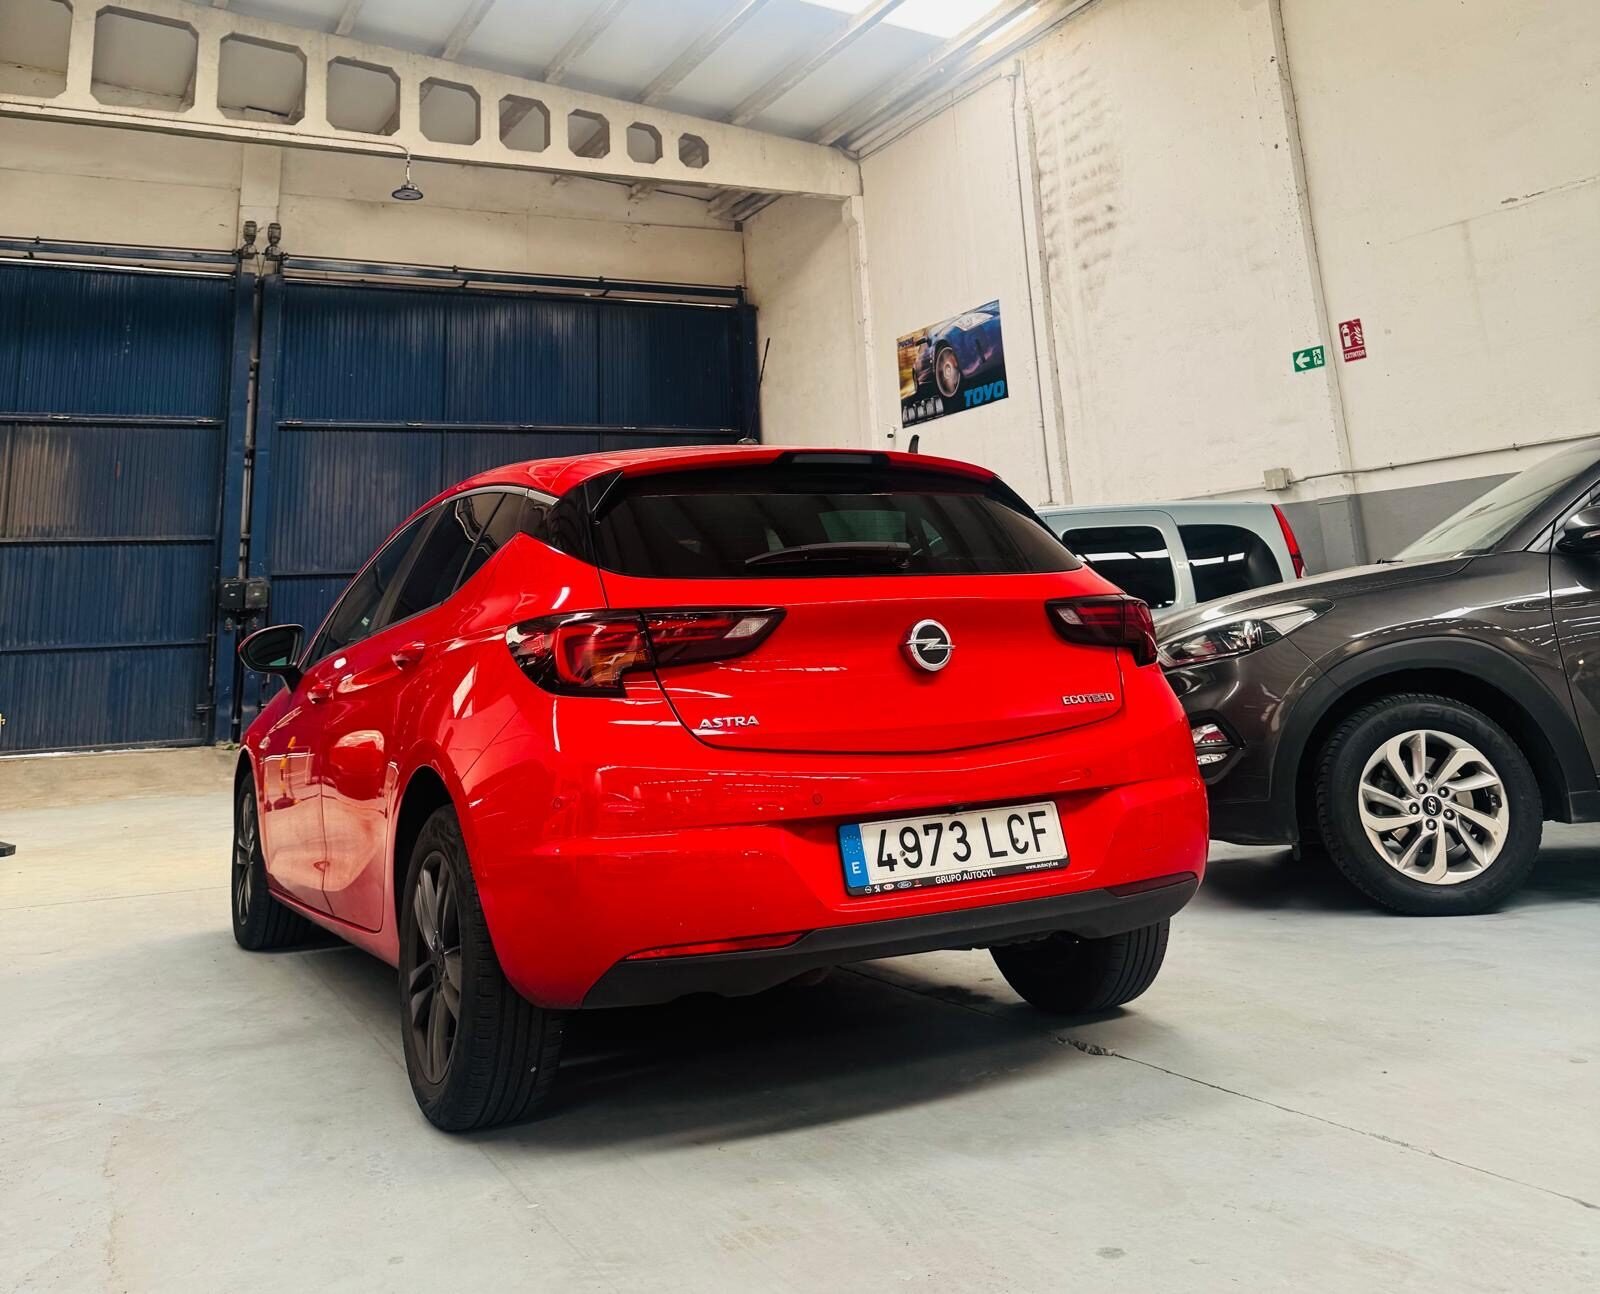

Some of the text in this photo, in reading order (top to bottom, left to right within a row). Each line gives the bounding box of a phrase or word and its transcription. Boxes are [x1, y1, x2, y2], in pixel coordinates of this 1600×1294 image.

[964, 380, 1004, 407] TOYO
[699, 715, 760, 729] ASTRA
[877, 810, 1047, 872] 4973 LCF
[852, 861, 861, 875] E
[935, 868, 997, 884] GRUPO AUTOCYL
